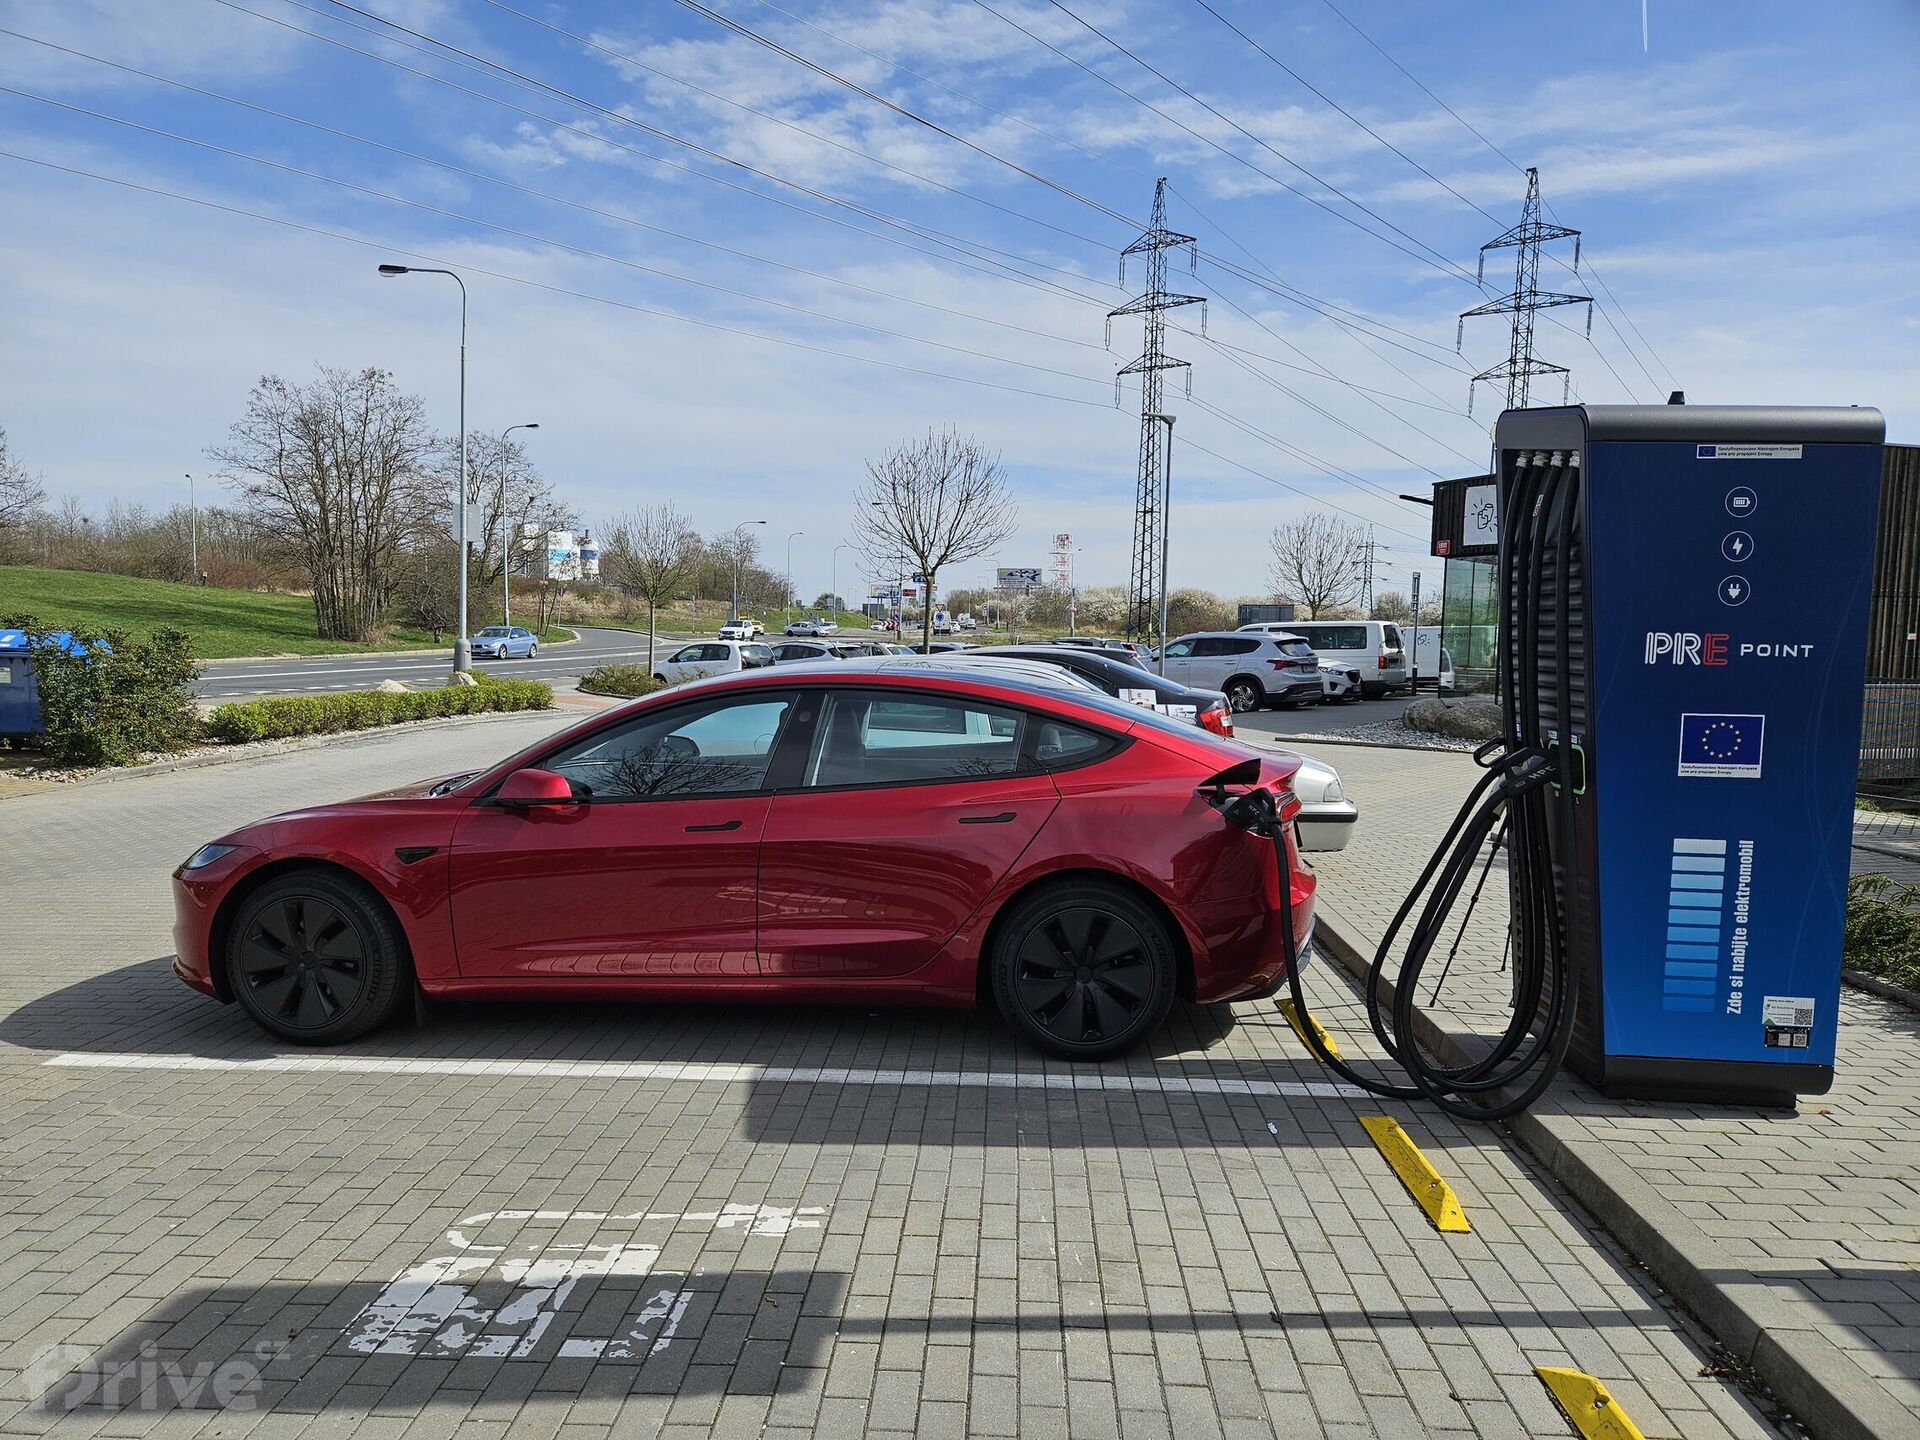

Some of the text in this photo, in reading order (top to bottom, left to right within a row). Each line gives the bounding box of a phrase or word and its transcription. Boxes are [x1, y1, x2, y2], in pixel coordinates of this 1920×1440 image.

[1644, 631, 1814, 666] PRE POINT
[1726, 840, 1754, 1014] Zde si nabijte elektromobil
